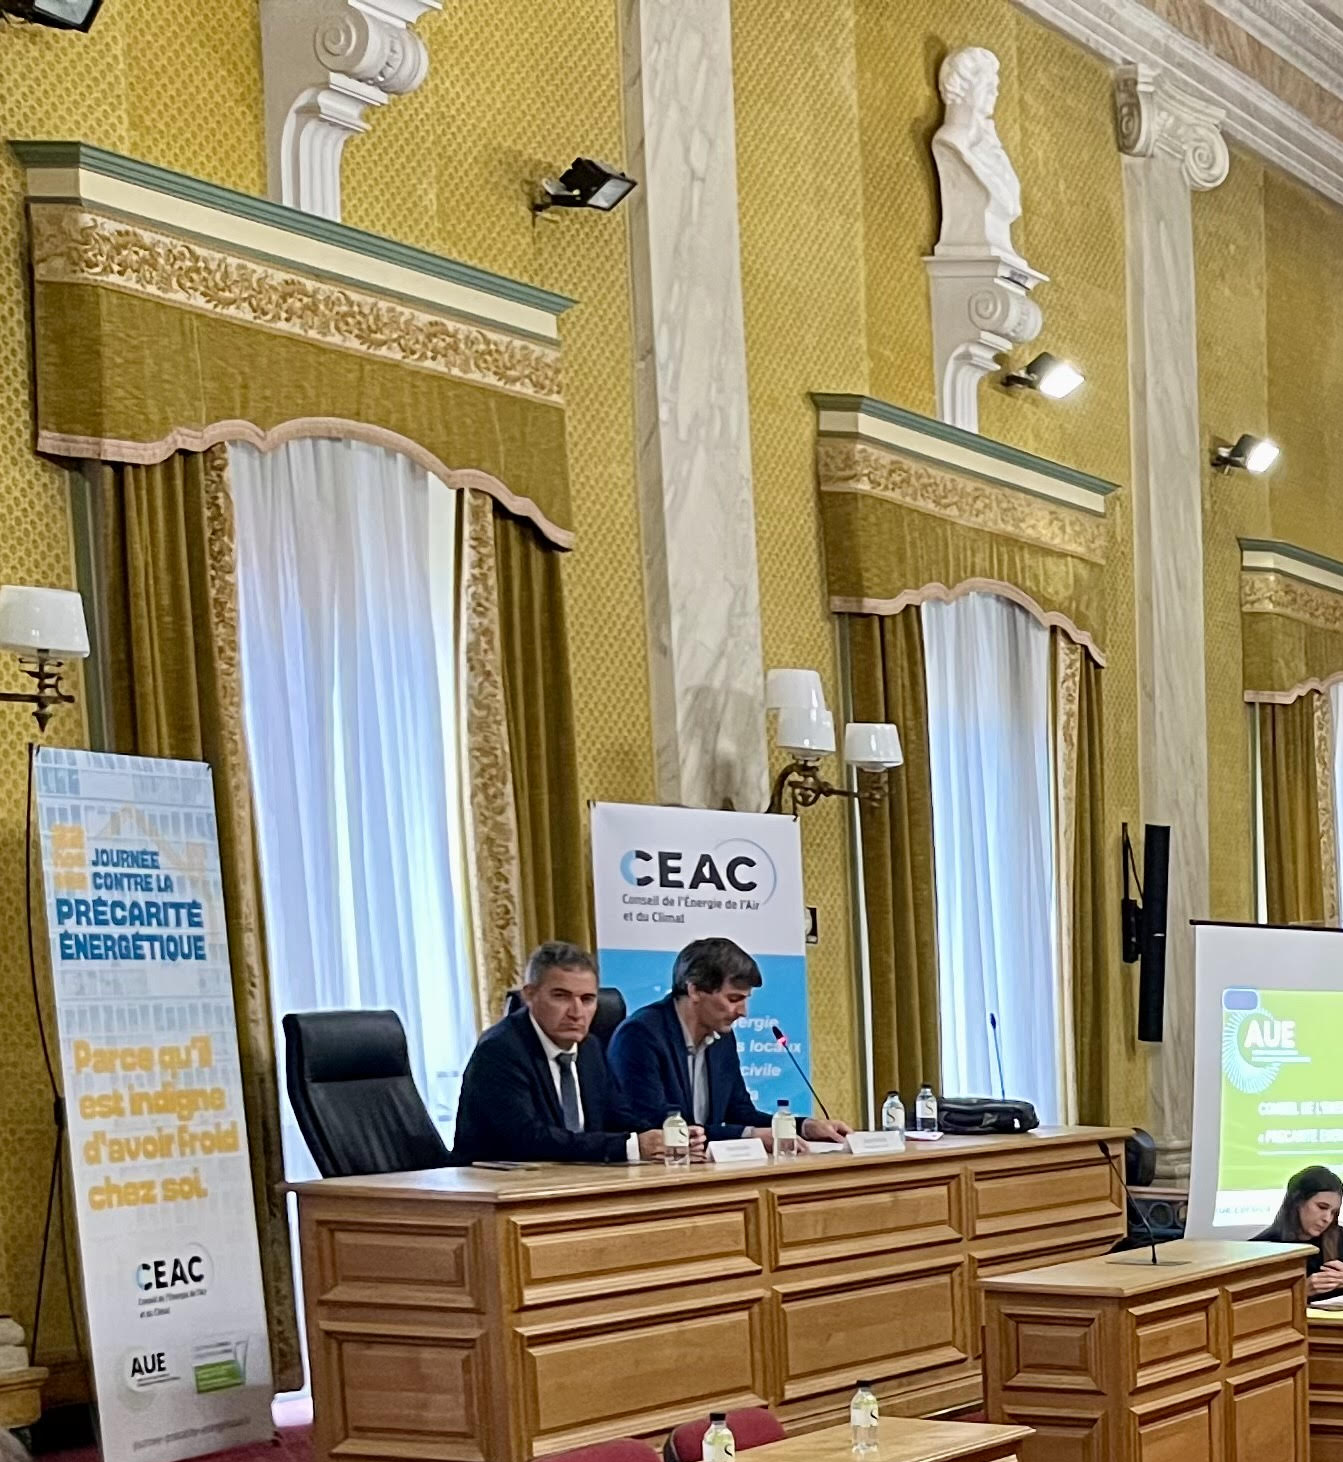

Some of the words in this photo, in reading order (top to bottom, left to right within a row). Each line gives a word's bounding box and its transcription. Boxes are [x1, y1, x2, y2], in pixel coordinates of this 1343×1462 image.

[92, 848, 160, 869] JOURNÉE
[620, 849, 758, 892] CEAC
[92, 872, 153, 892] CONTRE
[157, 874, 173, 892] LA
[56, 896, 203, 928] PRÉCARITÉ
[662, 895, 675, 906] de
[725, 897, 737, 909] de
[59, 930, 206, 961] ÉNERGÉTIQUE
[1244, 1019, 1296, 1049] AUE
[73, 1039, 154, 1075] Parce
[80, 1088, 125, 1120] est
[128, 1081, 226, 1122] indigne
[84, 1126, 174, 1165] d'avoir
[177, 1120, 239, 1157] froid
[88, 1176, 156, 1211] chez
[136, 1256, 205, 1291] CEAC
[131, 1352, 167, 1377] AUE
